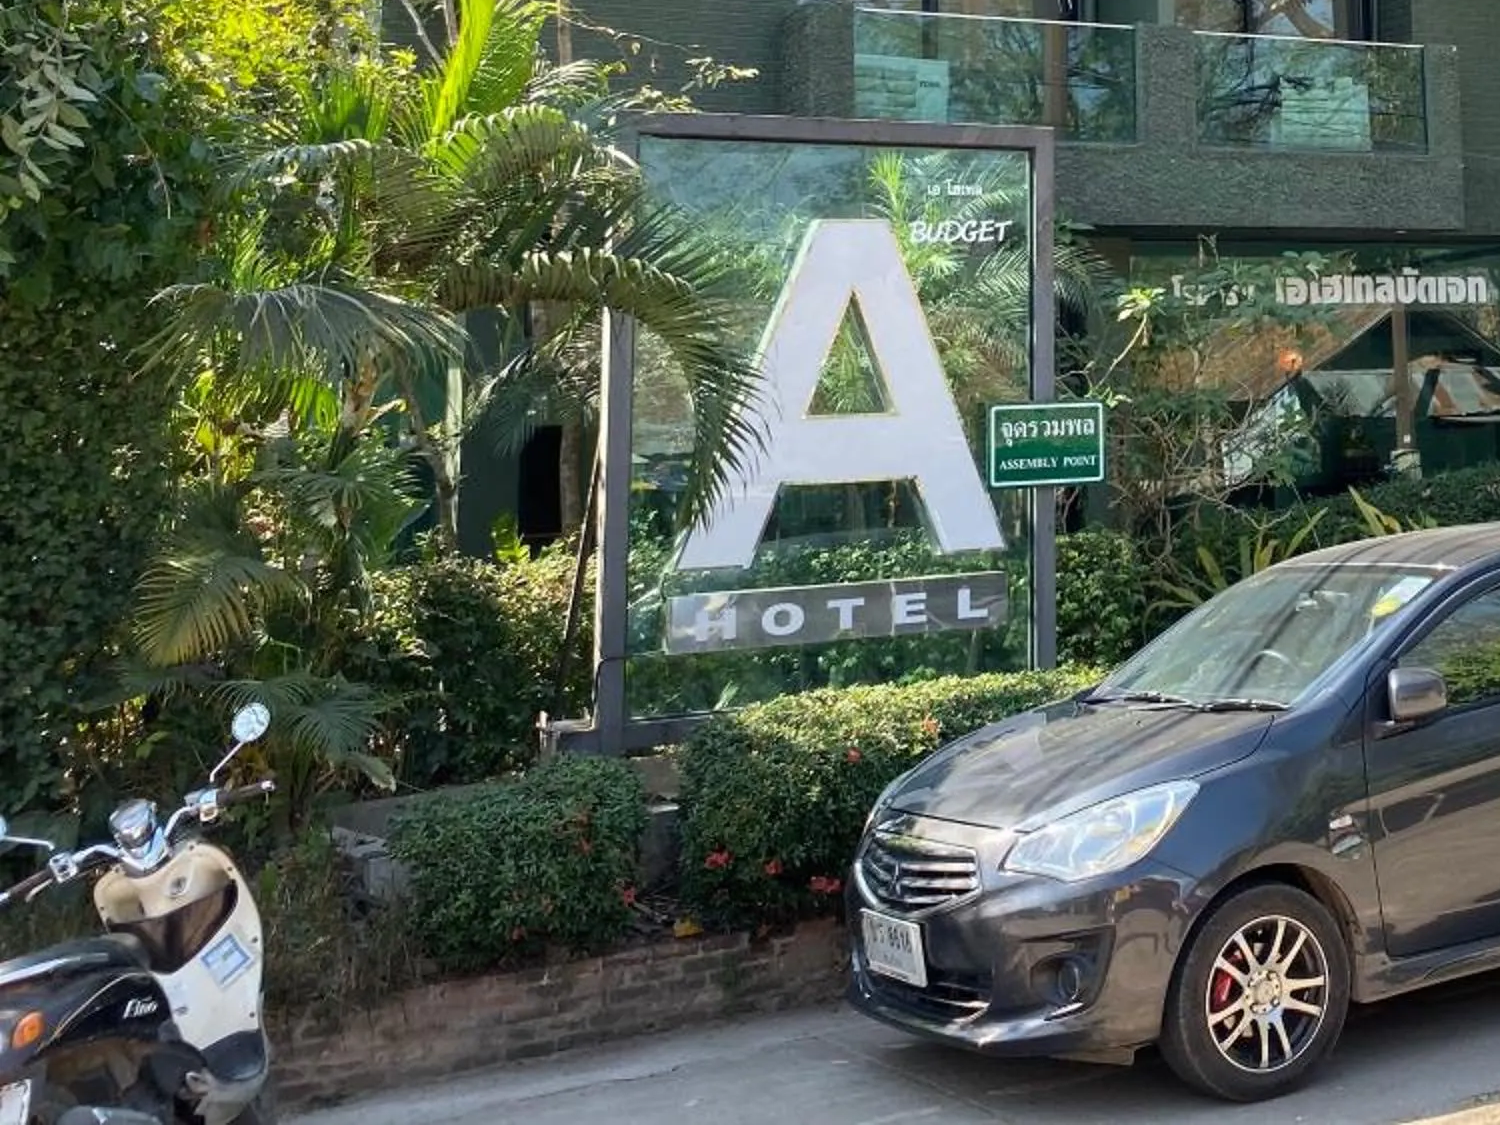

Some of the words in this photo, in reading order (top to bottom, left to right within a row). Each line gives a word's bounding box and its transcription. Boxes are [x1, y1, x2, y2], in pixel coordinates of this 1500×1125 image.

[909, 219, 1013, 243] BUDGET
[677, 218, 1006, 569] A
[1001, 418, 1095, 447] จุดรวมพล
[1000, 457, 1059, 471] ASSEMBLY
[1063, 454, 1096, 467] POINT
[694, 588, 989, 642] HOTEL
